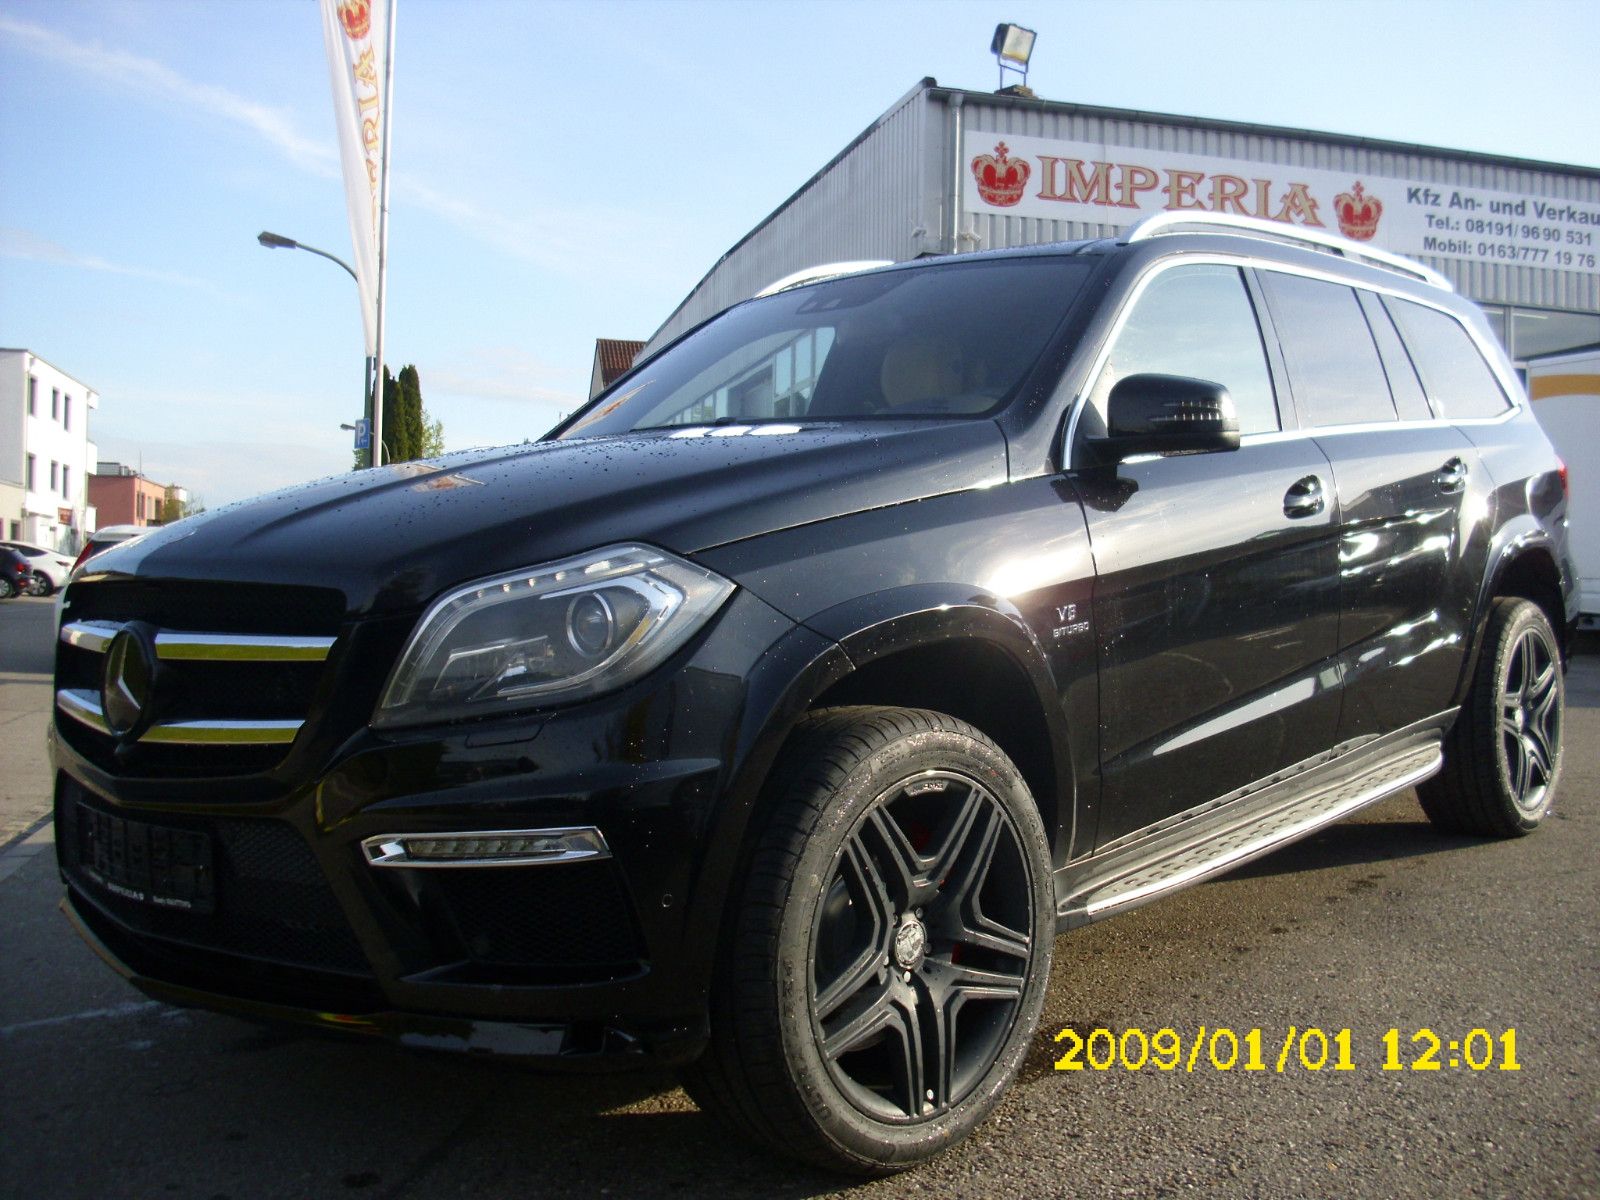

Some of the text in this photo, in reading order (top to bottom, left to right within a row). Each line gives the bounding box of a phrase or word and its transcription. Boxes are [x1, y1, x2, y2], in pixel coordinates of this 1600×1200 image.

[1036, 155, 1326, 229] IMPERIA
[1406, 187, 1441, 207] Kfz
[1448, 191, 1482, 212] An-
[1489, 200, 1526, 217] und
[1425, 214, 1460, 232] Tel.:
[1565, 230, 1592, 247] 531
[1423, 236, 1596, 268] Mobil: 0163/777 19 76
